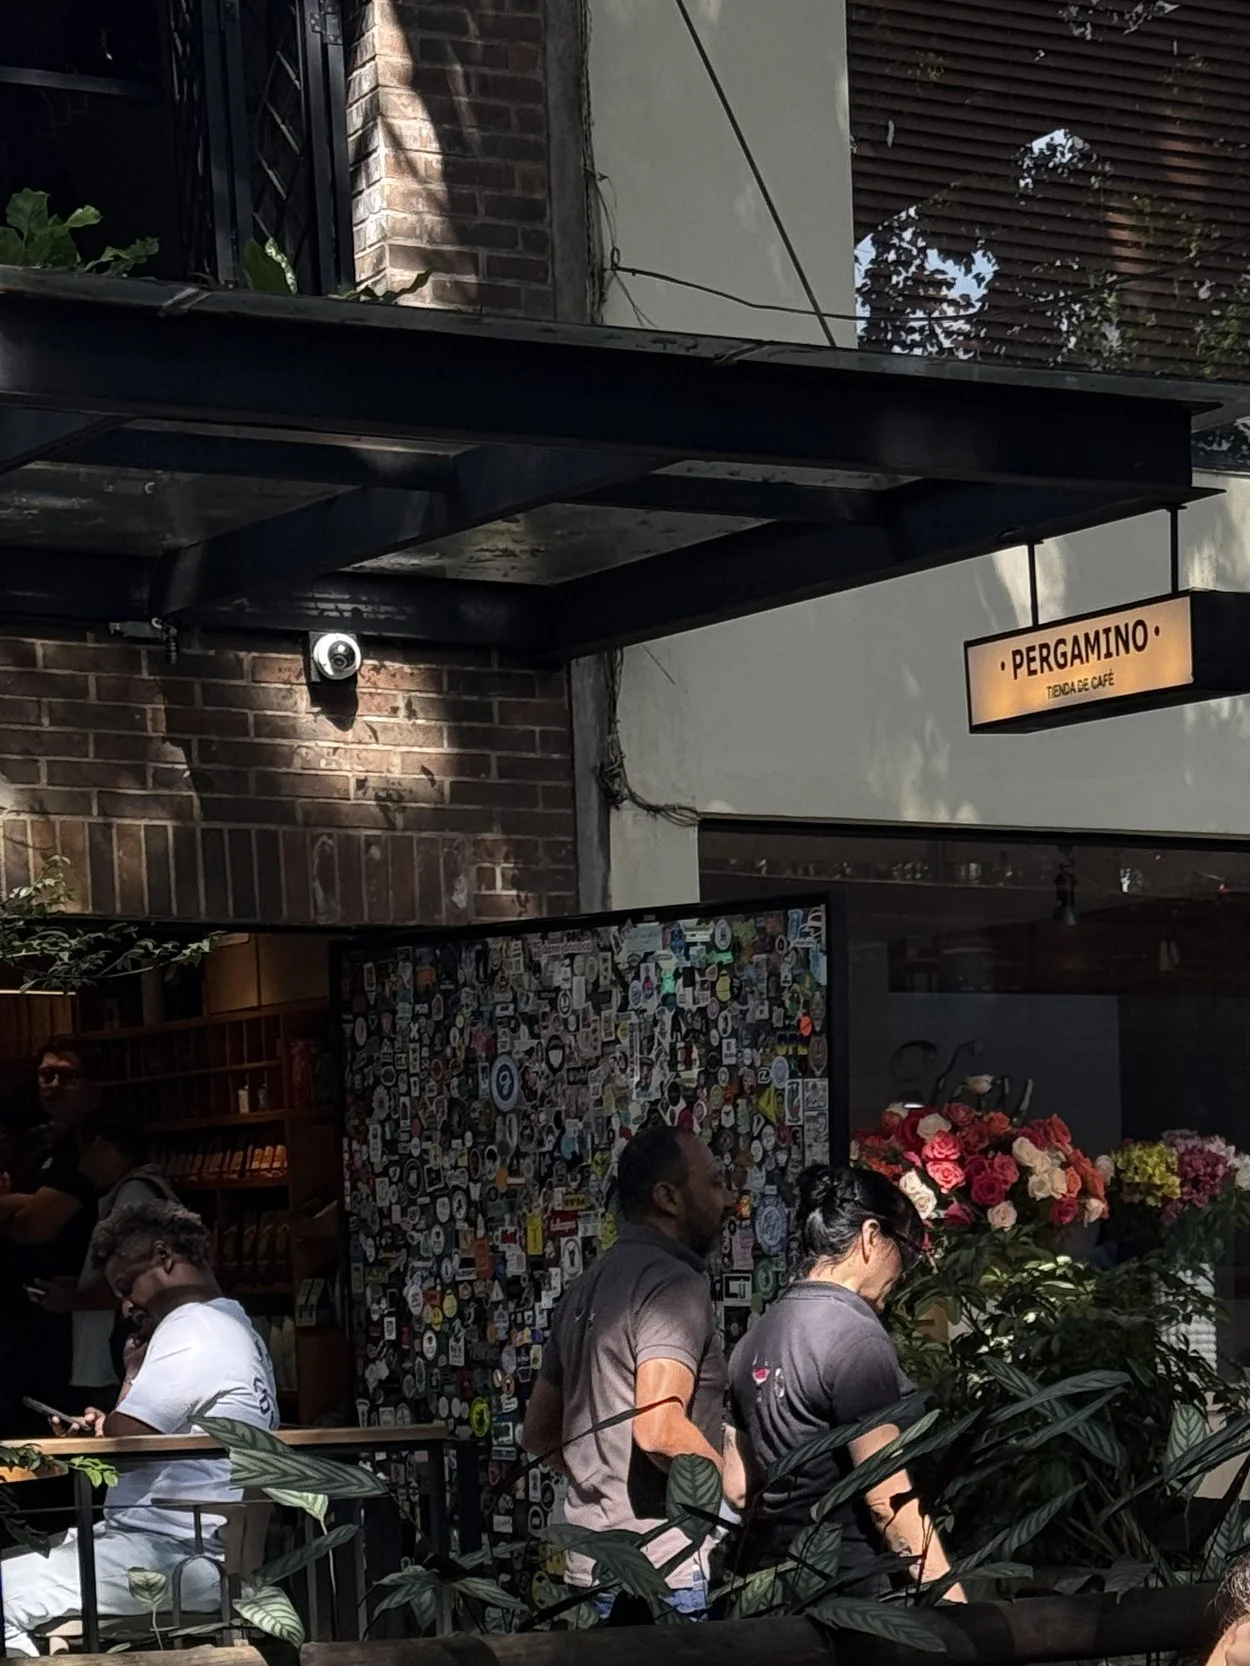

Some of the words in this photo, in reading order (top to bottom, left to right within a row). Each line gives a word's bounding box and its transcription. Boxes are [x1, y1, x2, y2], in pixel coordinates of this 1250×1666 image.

[1046, 681, 1076, 699] TIENDA
[1077, 677, 1089, 693] DE
[1091, 668, 1115, 690] CAFÉ
